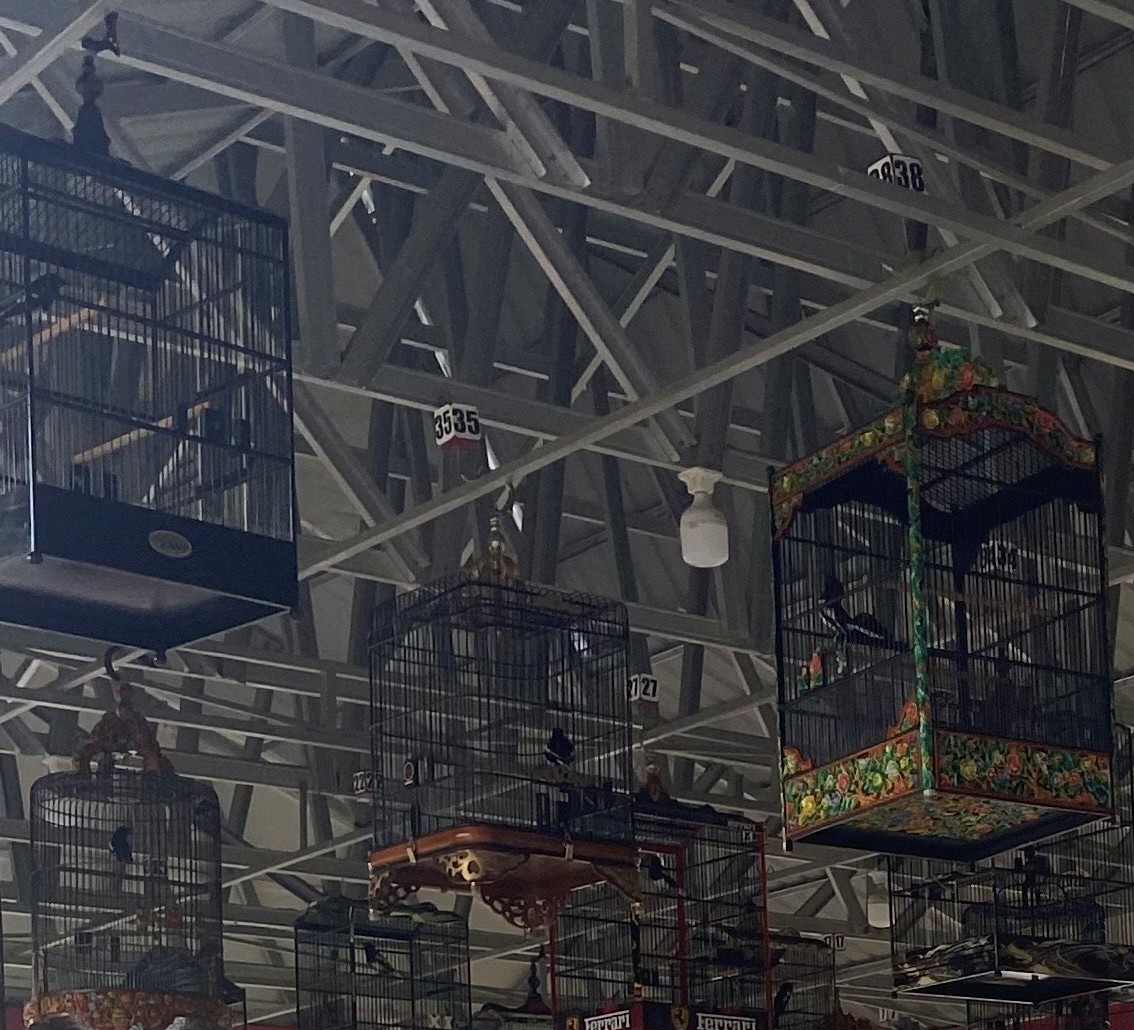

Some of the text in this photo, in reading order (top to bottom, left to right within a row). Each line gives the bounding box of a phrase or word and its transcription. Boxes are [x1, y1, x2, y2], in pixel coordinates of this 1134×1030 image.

[894, 160, 924, 191] 38
[434, 410, 452, 439] 35
[452, 408, 480, 434] 35
[641, 677, 658, 697] 27
